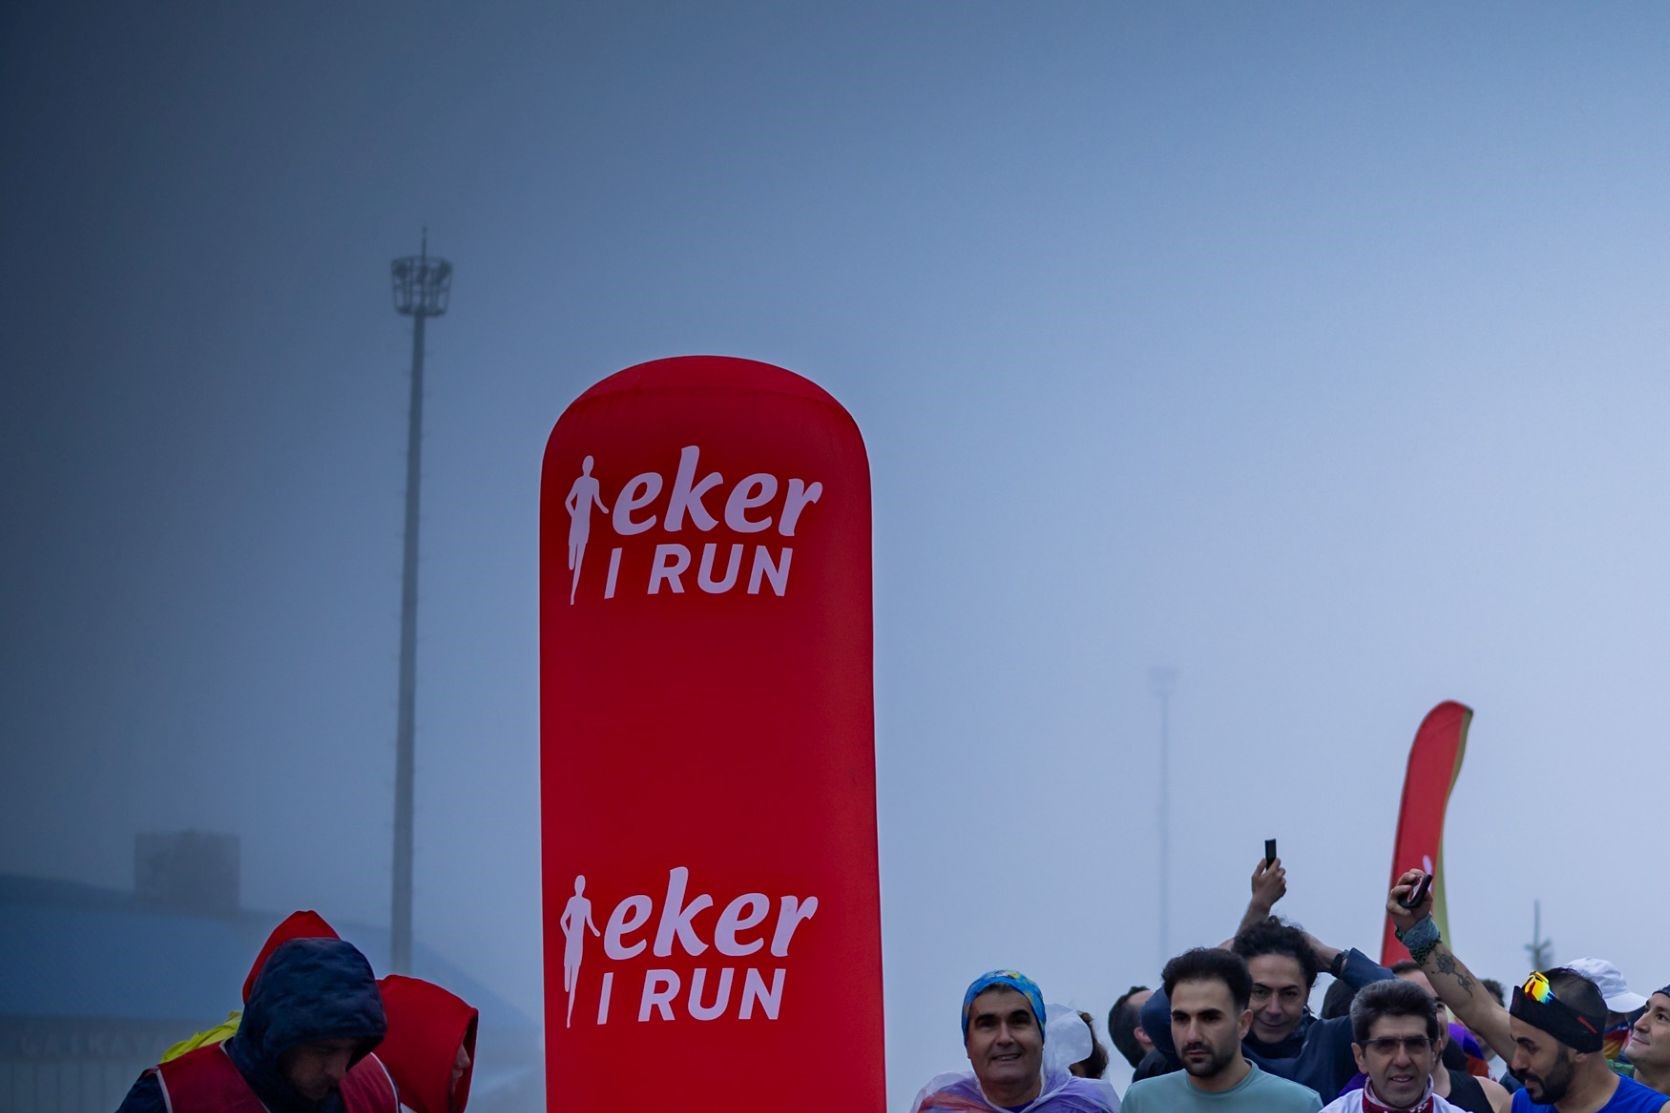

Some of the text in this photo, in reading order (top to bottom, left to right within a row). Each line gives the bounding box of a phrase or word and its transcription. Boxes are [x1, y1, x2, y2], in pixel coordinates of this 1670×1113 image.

[612, 445, 823, 536] eker
[604, 543, 793, 599] I RUN
[604, 866, 818, 960] eker
[597, 968, 786, 1024] I RUN
